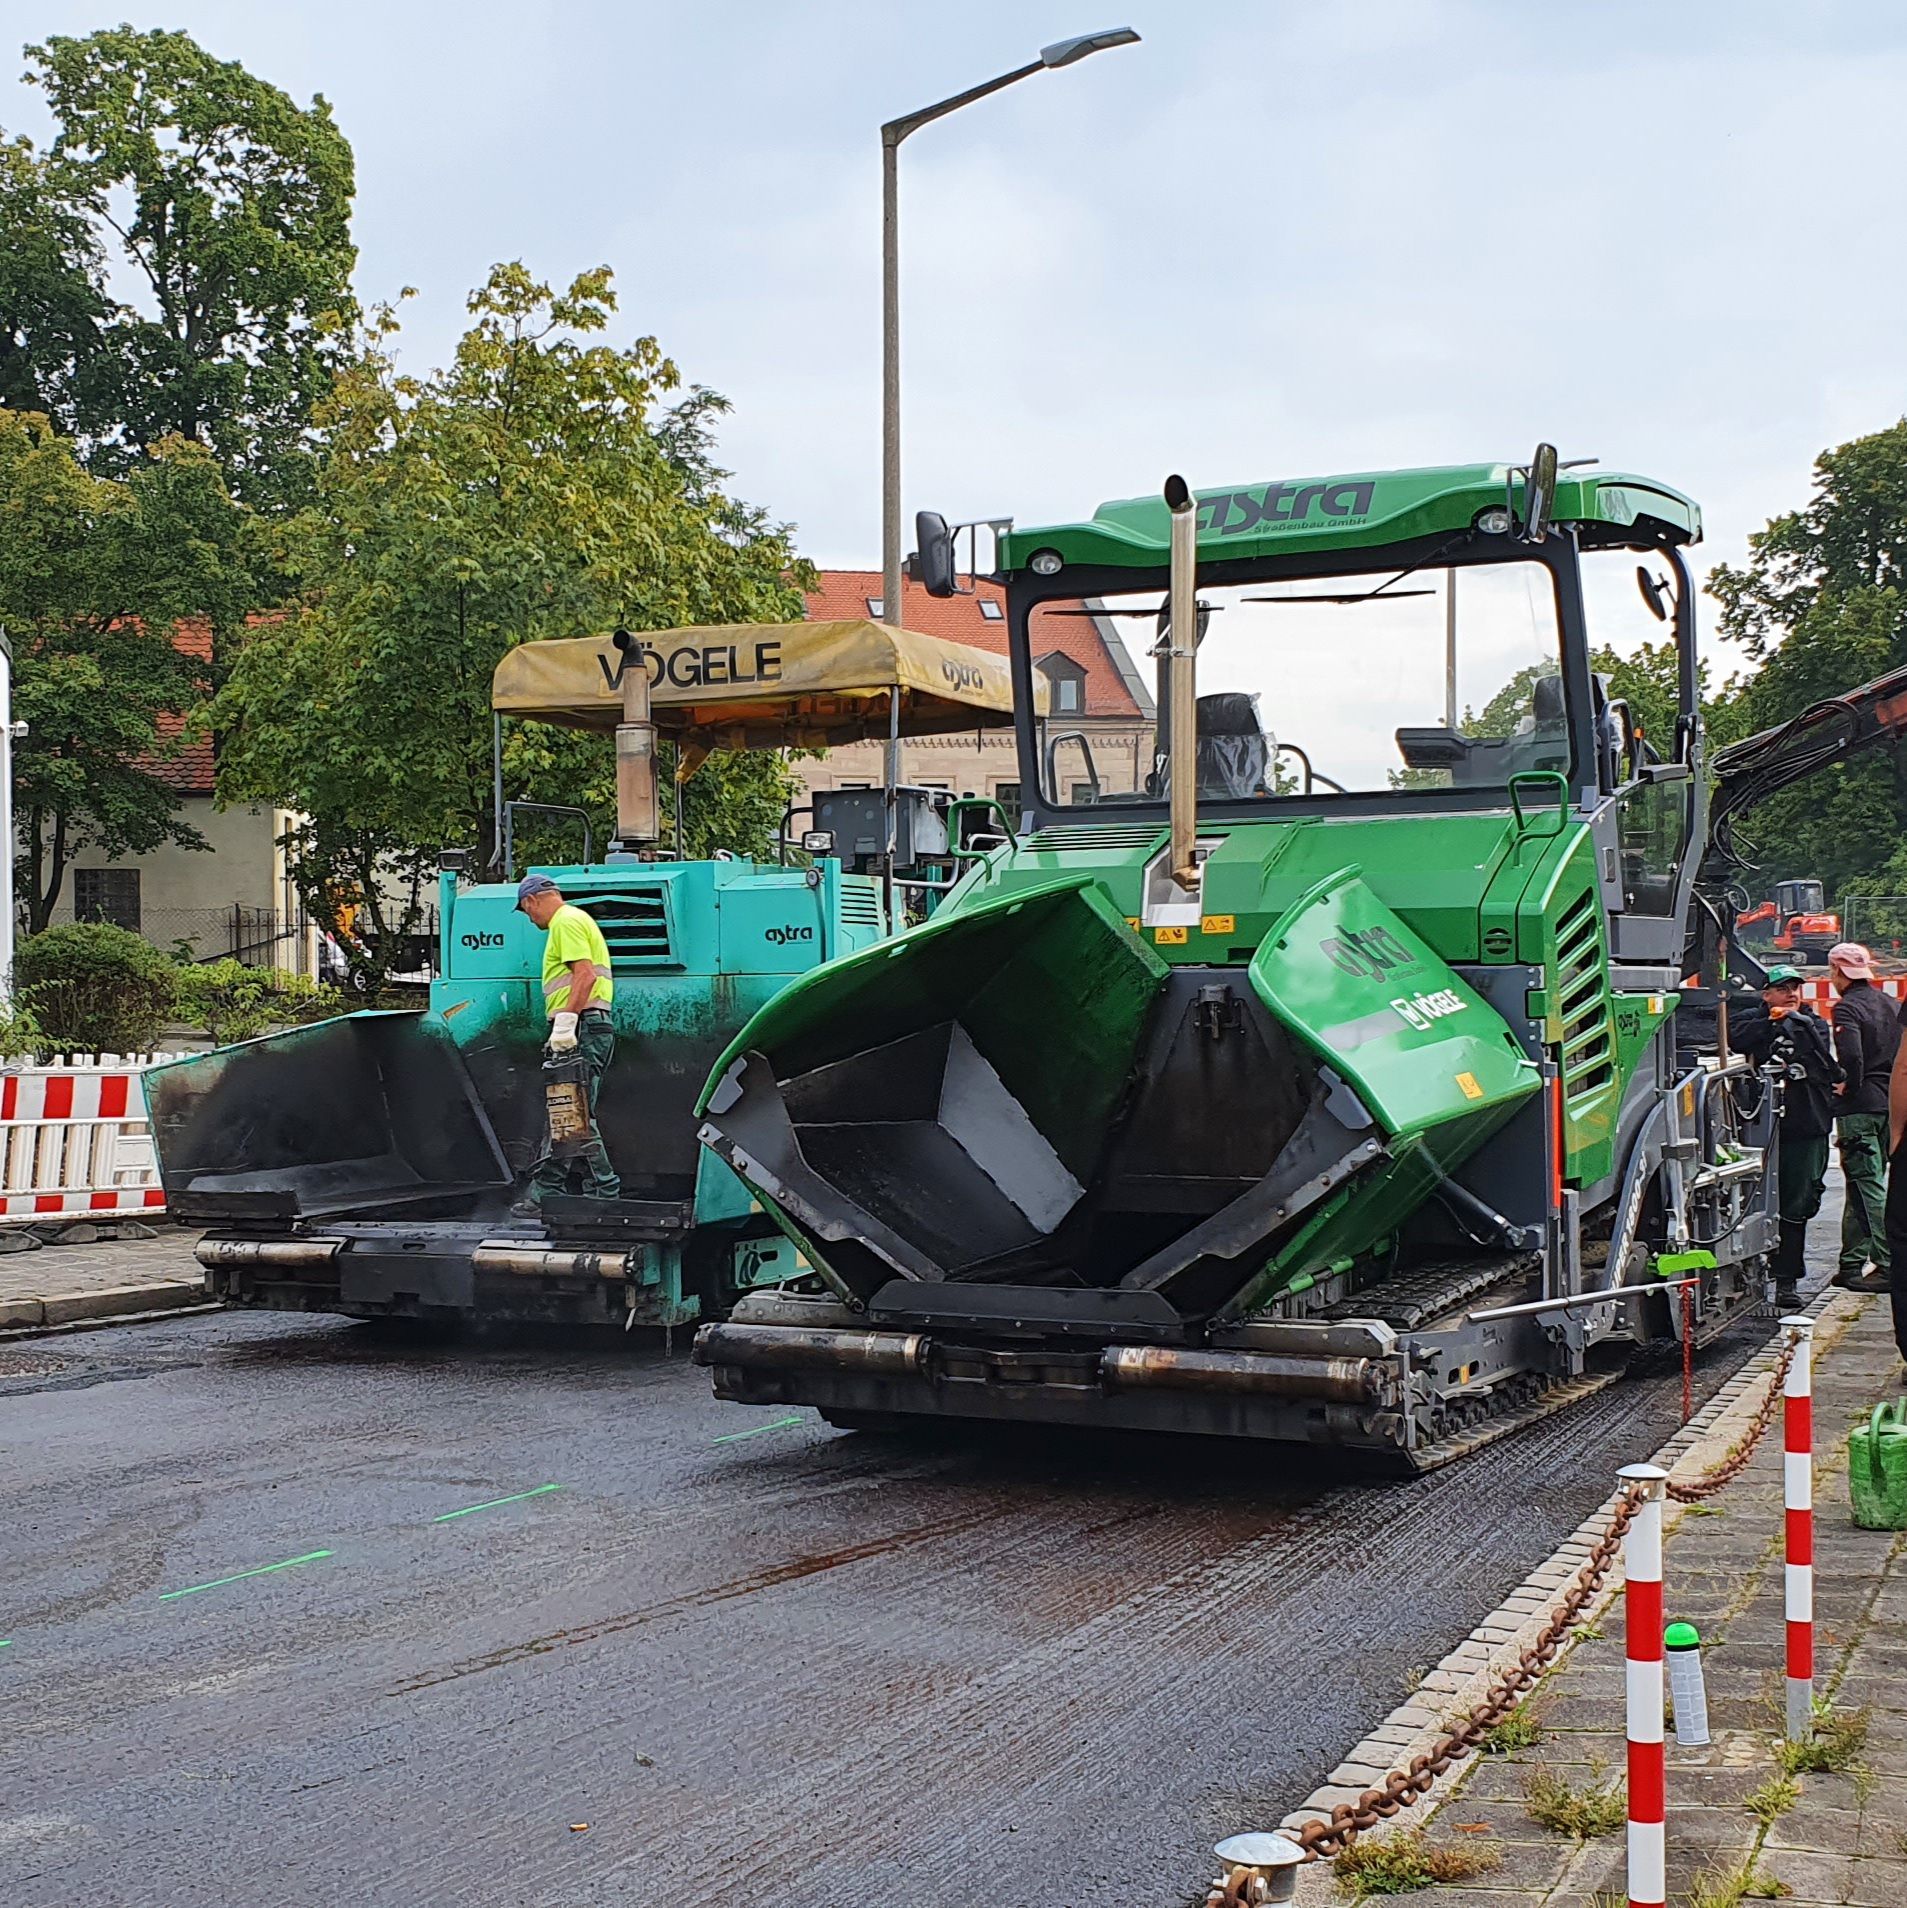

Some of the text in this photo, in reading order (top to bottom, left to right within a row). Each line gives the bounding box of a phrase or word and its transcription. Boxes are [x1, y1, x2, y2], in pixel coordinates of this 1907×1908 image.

[1197, 482, 1375, 535] astra
[1327, 517, 1366, 527] GmbH
[461, 931, 504, 950] astra
[765, 925, 813, 945] astra
